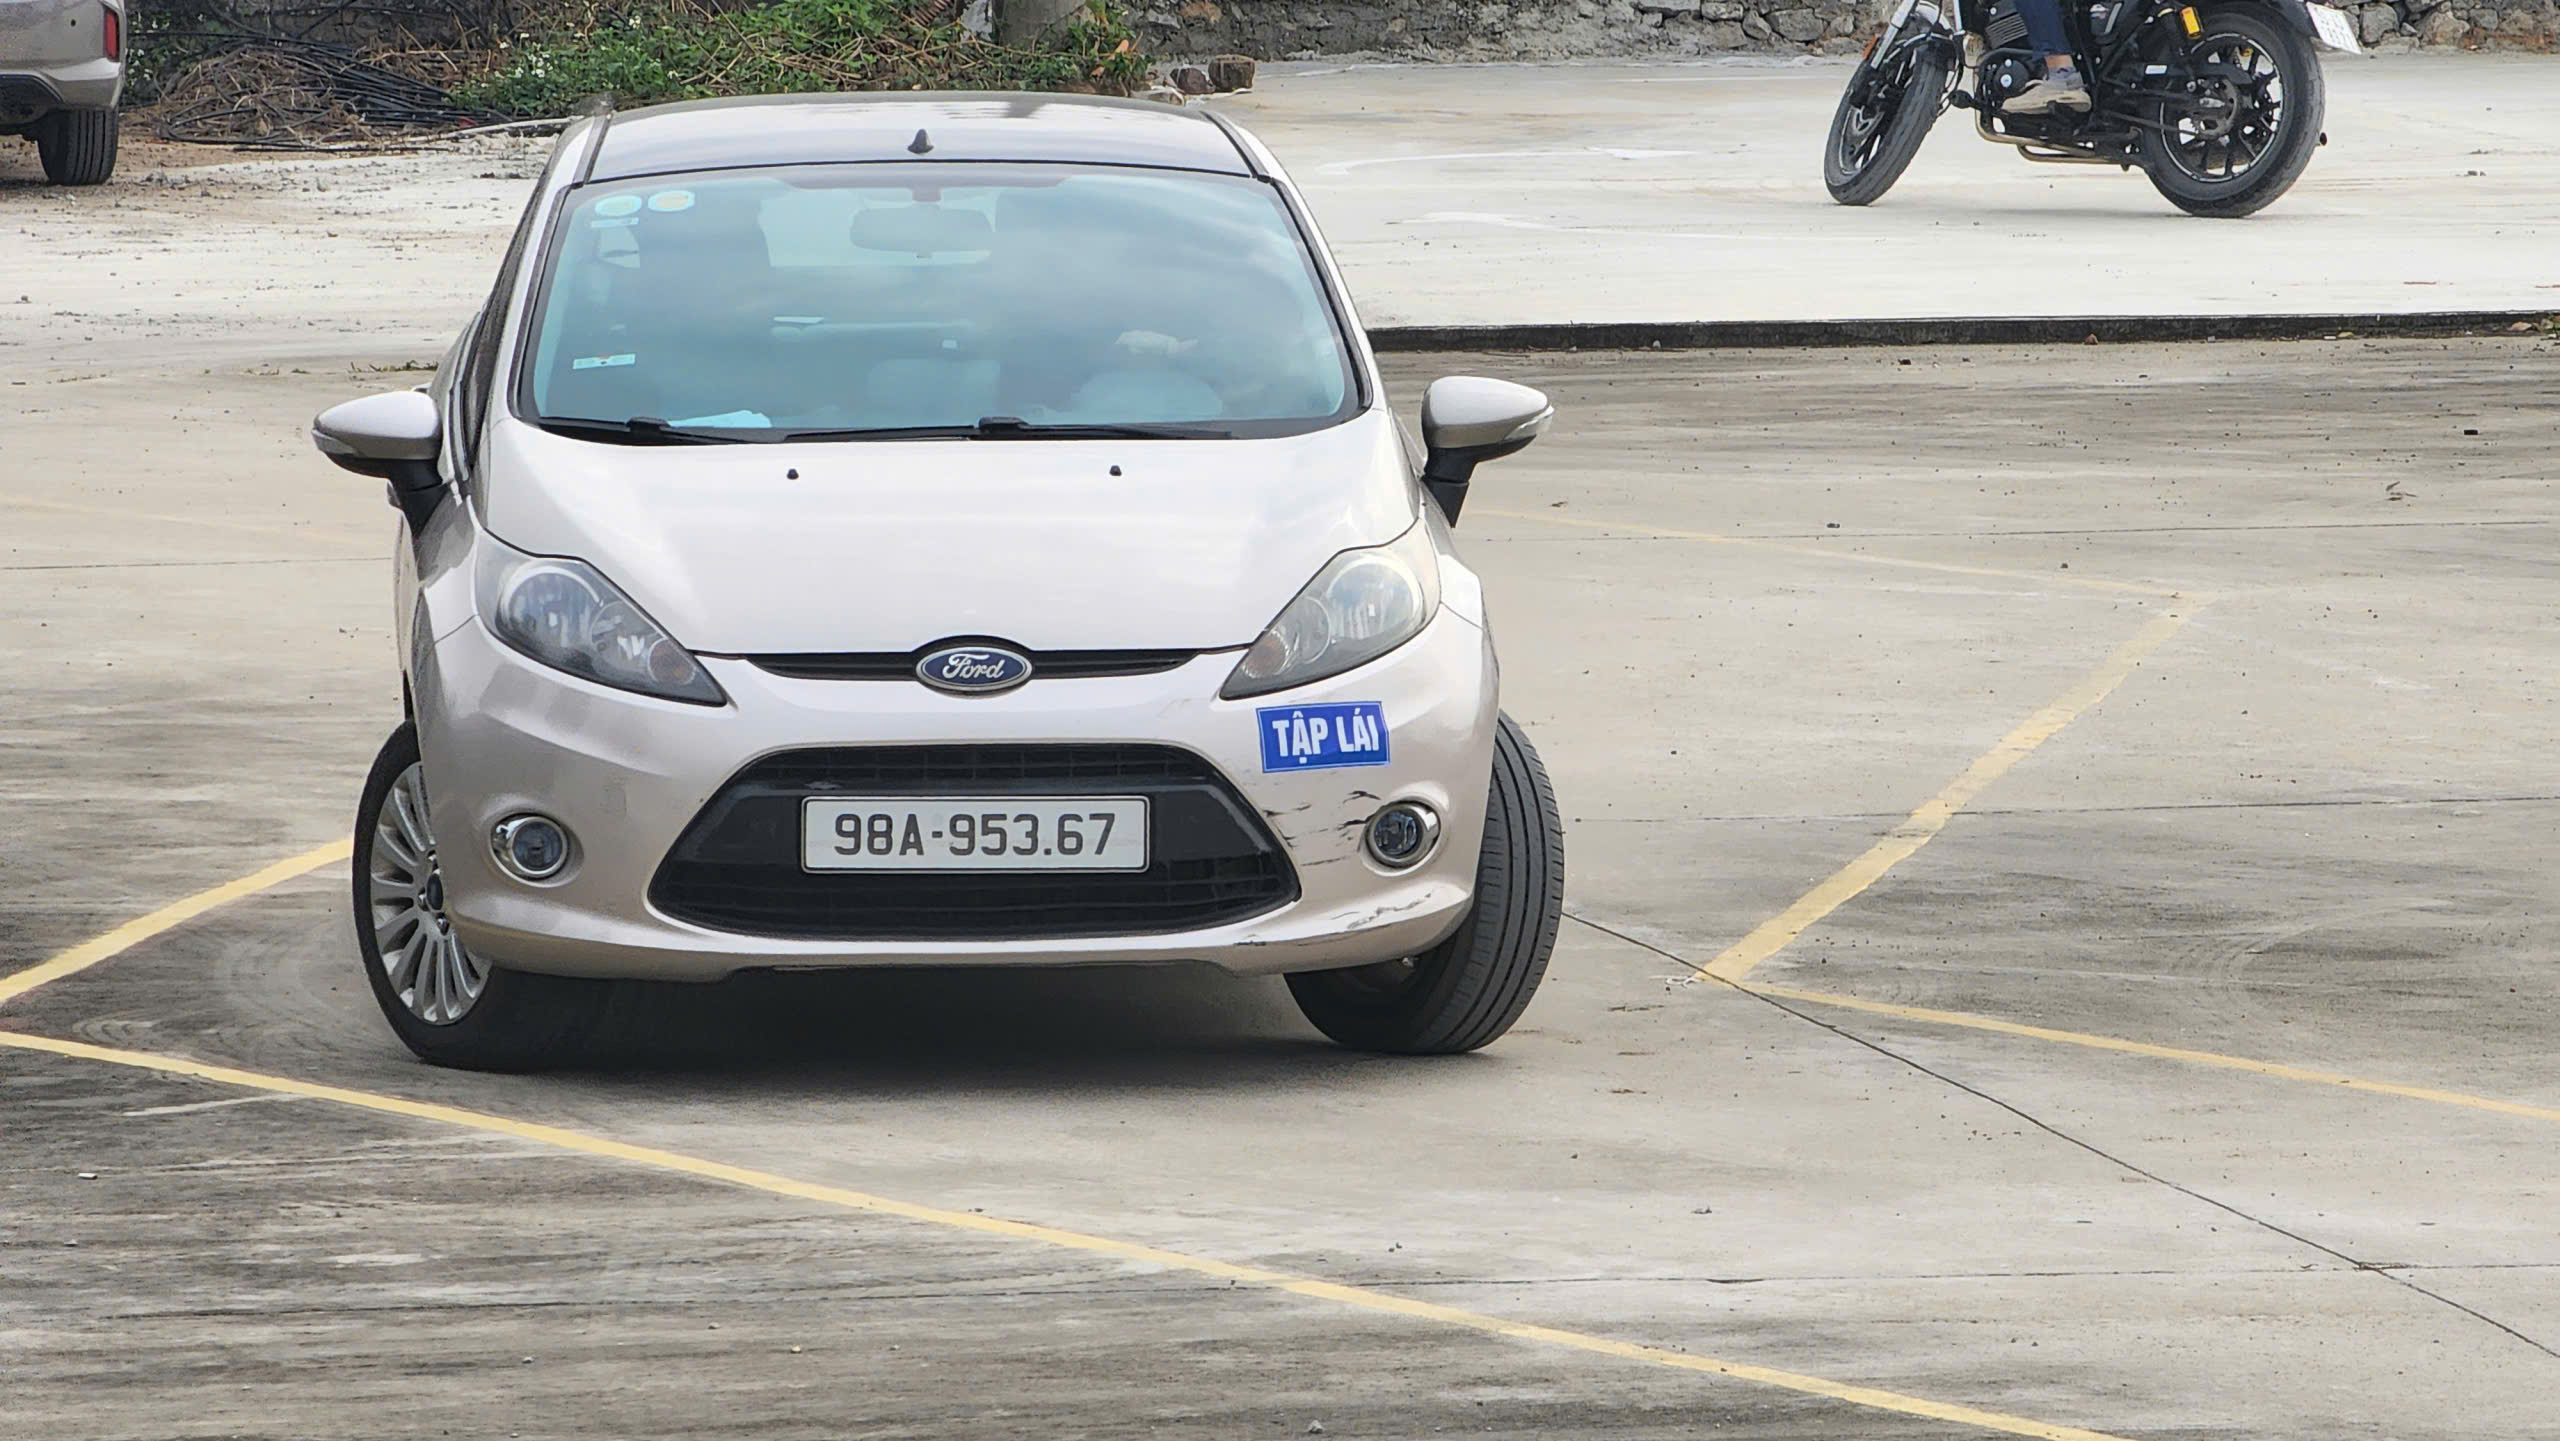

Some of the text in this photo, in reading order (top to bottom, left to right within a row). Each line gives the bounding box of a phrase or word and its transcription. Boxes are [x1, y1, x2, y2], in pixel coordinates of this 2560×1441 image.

[942, 653, 1005, 679] Ford
[1272, 707, 1379, 764] TẬP LÁI
[834, 813, 1115, 856] 98A-953.67
